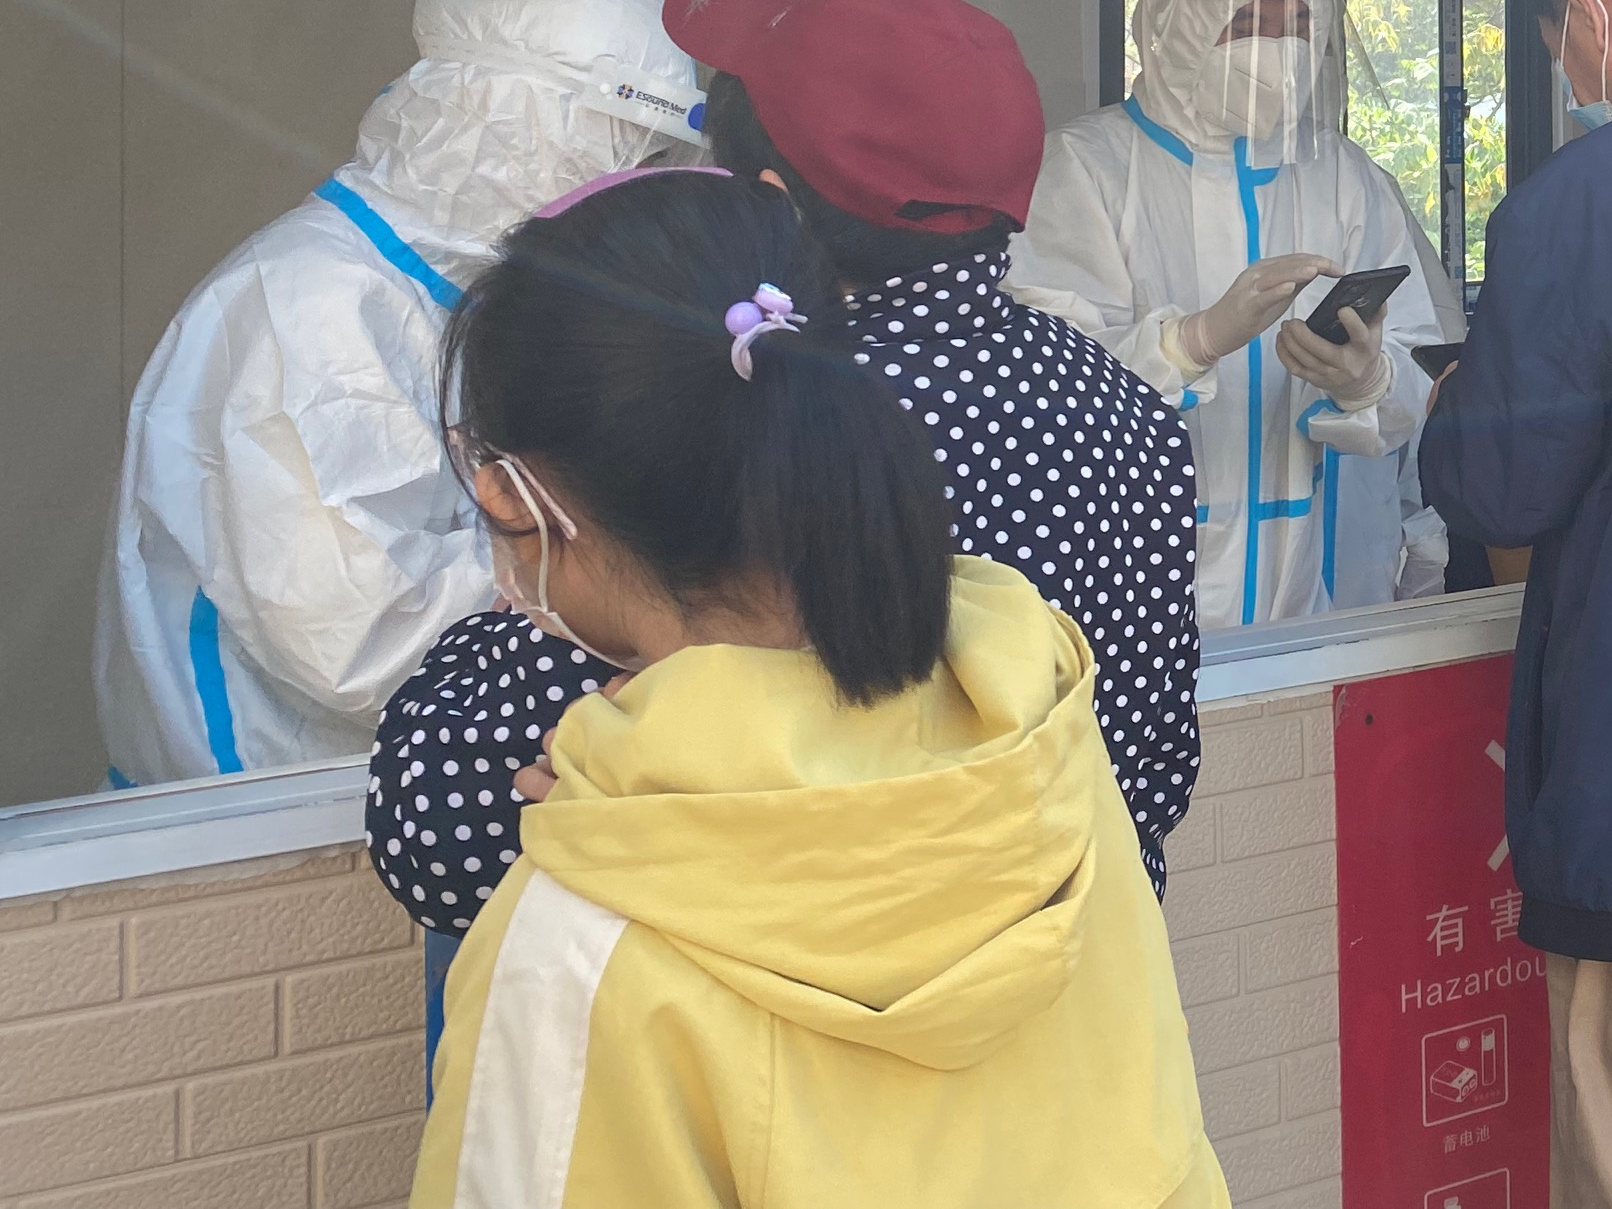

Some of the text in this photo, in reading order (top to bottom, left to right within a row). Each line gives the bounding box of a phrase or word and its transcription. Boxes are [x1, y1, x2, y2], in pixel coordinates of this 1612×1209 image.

[669, 102, 687, 115] Med
[1443, 1124, 1491, 1155] 蓄电池
